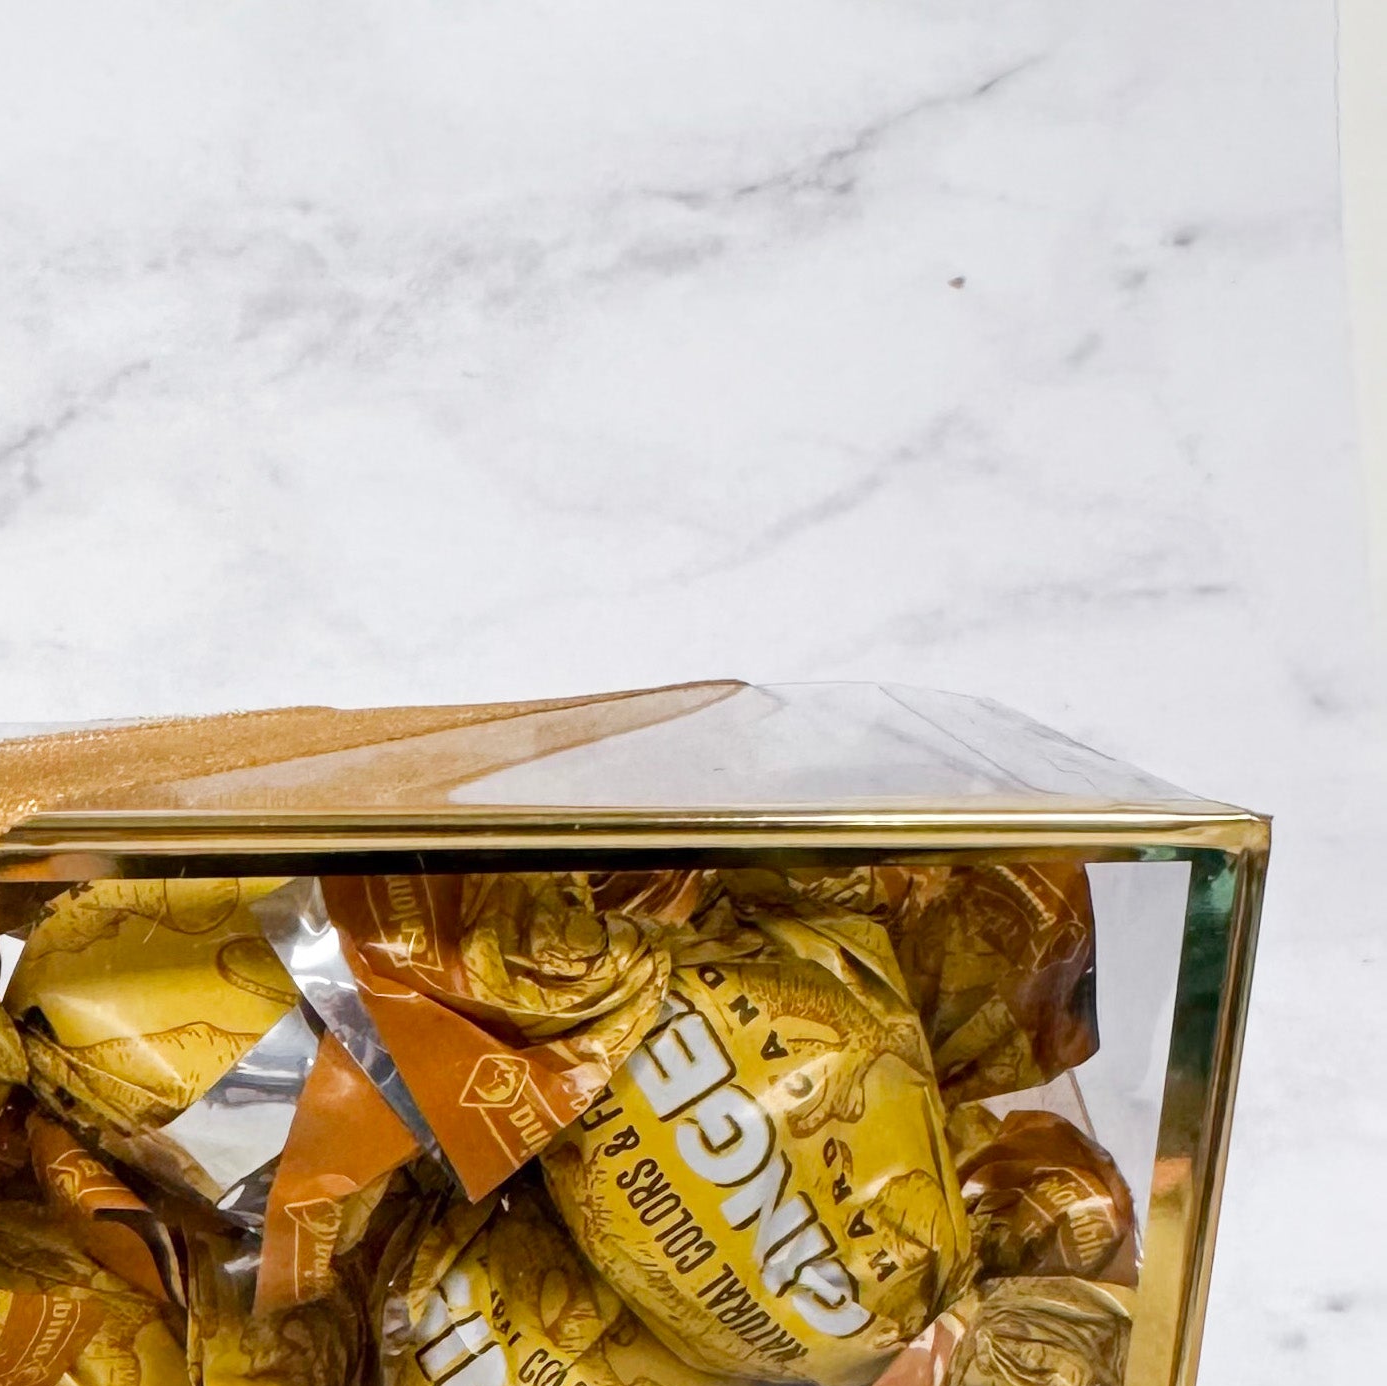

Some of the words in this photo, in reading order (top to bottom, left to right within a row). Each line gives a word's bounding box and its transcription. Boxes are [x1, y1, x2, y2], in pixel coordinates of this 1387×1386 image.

[698, 965, 813, 1099] CAND
[603, 1125, 641, 1158] &
[626, 990, 876, 1338] GINGE
[616, 1156, 716, 1275] COLORS
[696, 1263, 810, 1361] NATURAL
